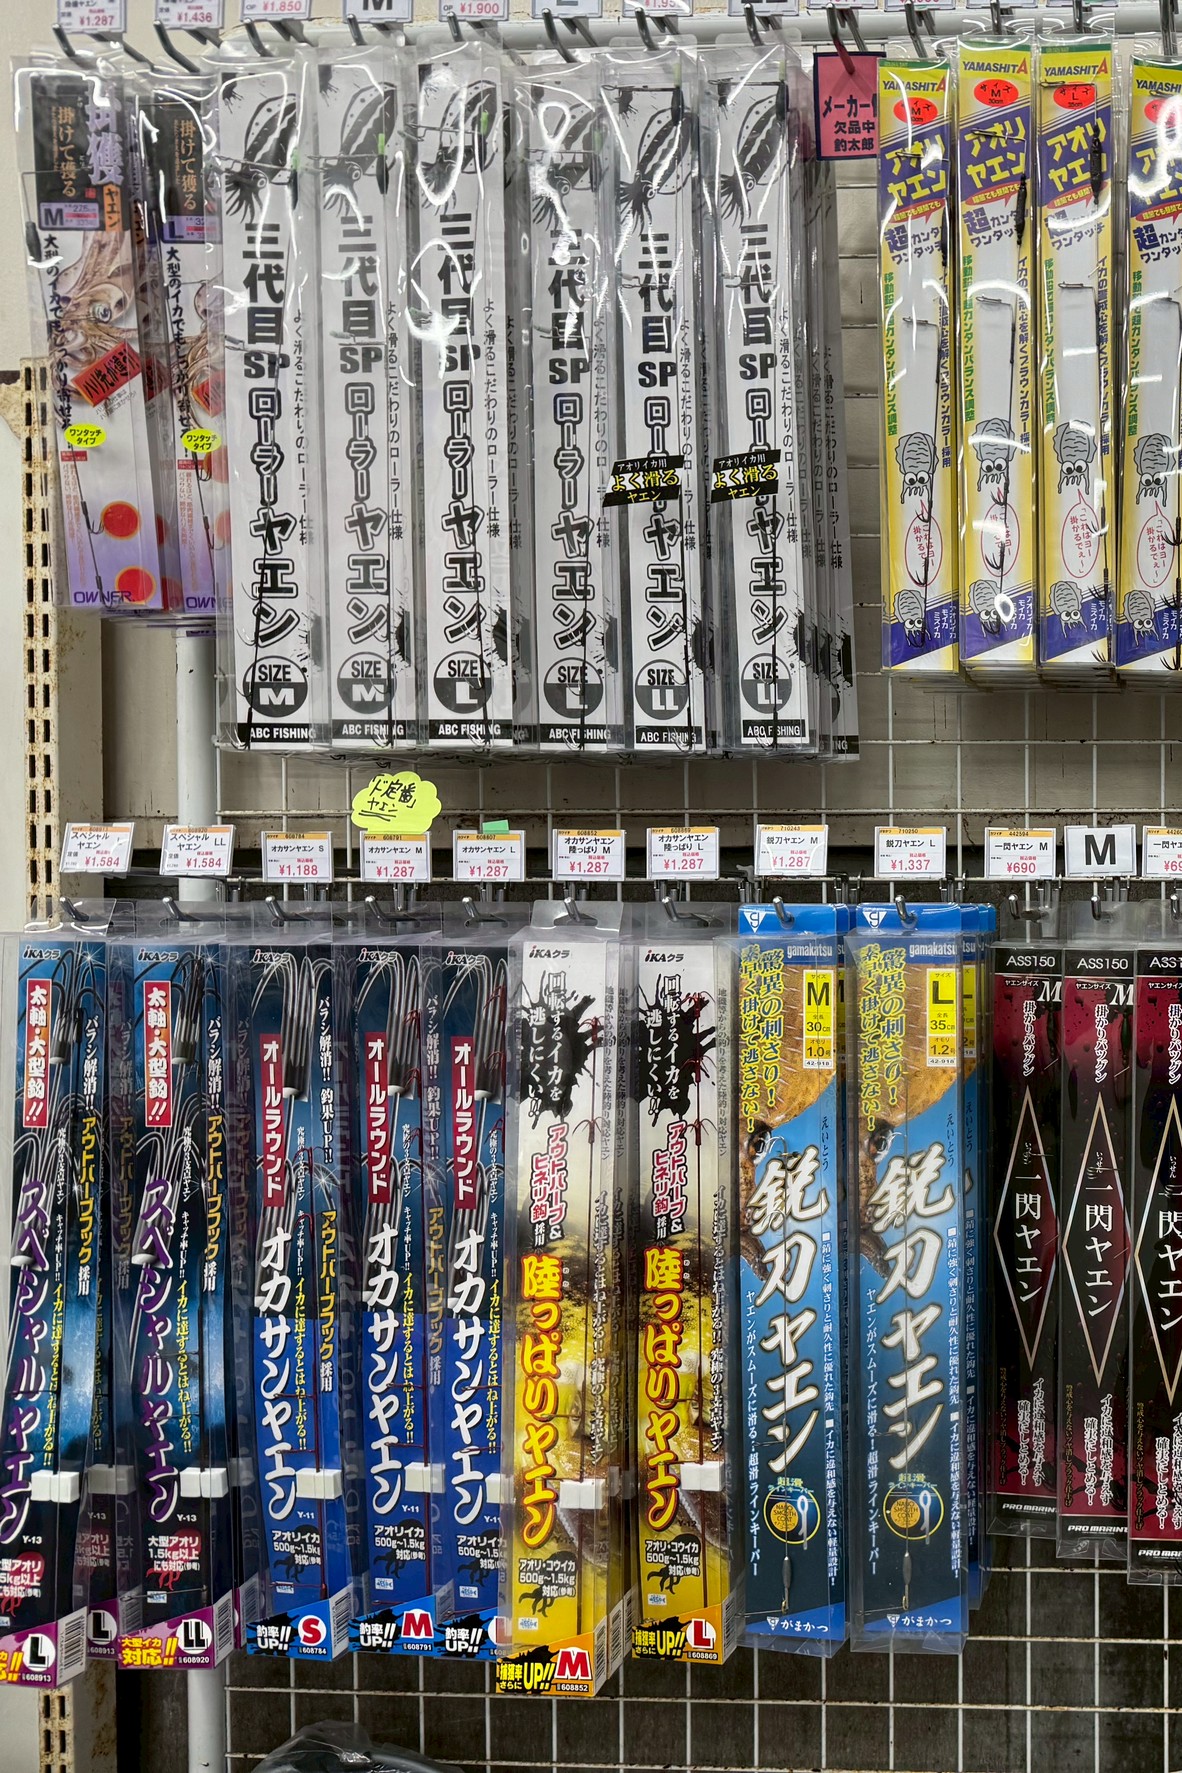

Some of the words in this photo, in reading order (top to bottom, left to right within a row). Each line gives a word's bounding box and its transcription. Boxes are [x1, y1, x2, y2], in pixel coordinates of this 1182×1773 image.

[962, 57, 1028, 75] YAMASHITA
[1044, 57, 1109, 77] YAMASHITA
[834, 120, 876, 135] 欠品中
[834, 137, 875, 152] 釣太郎
[44, 208, 64, 226] M
[962, 206, 992, 237] 超
[69, 427, 102, 440] ワンタッチ
[76, 437, 97, 446] タイプ
[193, 441, 212, 451] タイプ
[612, 469, 679, 491] よく滑る
[627, 489, 662, 501] ヤエン
[74, 590, 132, 605] OWNER
[259, 664, 292, 683] SIZE
[448, 659, 479, 678] SIZE
[647, 668, 675, 686] SIZE
[259, 687, 296, 706] M
[456, 681, 478, 704] L
[652, 689, 678, 711] LL
[250, 727, 272, 739] ABC
[640, 731, 659, 743] ABC
[71, 832, 110, 840] スペシャル
[170, 833, 209, 841] スペシャル
[214, 837, 227, 846] LL
[565, 837, 615, 845] オカサンヤエン
[766, 836, 805, 845] 鋭刀ヤエン
[886, 839, 925, 848] 鋭刀ヤエン
[77, 841, 102, 850] ヤエン
[177, 843, 202, 851] ヤエン
[368, 846, 411, 854] オカサンヤエン
[415, 847, 423, 855] M
[462, 845, 505, 854] オカサンヤエン
[510, 846, 516, 854] L
[568, 846, 598, 854] 陸っぱり
[603, 846, 610, 854] M
[663, 843, 692, 852] 陸っぱり
[698, 843, 704, 851] L
[1039, 842, 1048, 851] M
[1084, 834, 1116, 865] M
[1006, 862, 1036, 874] ¥690
[787, 943, 832, 959] gamakatsu
[909, 942, 957, 958] gamakatsu
[1006, 955, 1056, 968] ASS150
[1077, 956, 1129, 971] ASS150
[807, 981, 830, 1007] M
[931, 980, 954, 1005] L
[262, 1041, 283, 1199] オールラウンド
[367, 1038, 387, 1197] オールラウンド
[259, 1228, 297, 1521] オカサンヤエン
[366, 1222, 403, 1515] オカサンヤエン
[402, 1613, 433, 1637] M
[780, 1618, 829, 1633] がまかつ
[901, 1615, 952, 1628] がまかつ
[302, 1618, 322, 1644] S
[692, 1620, 712, 1648] L
[556, 1651, 591, 1679] M
